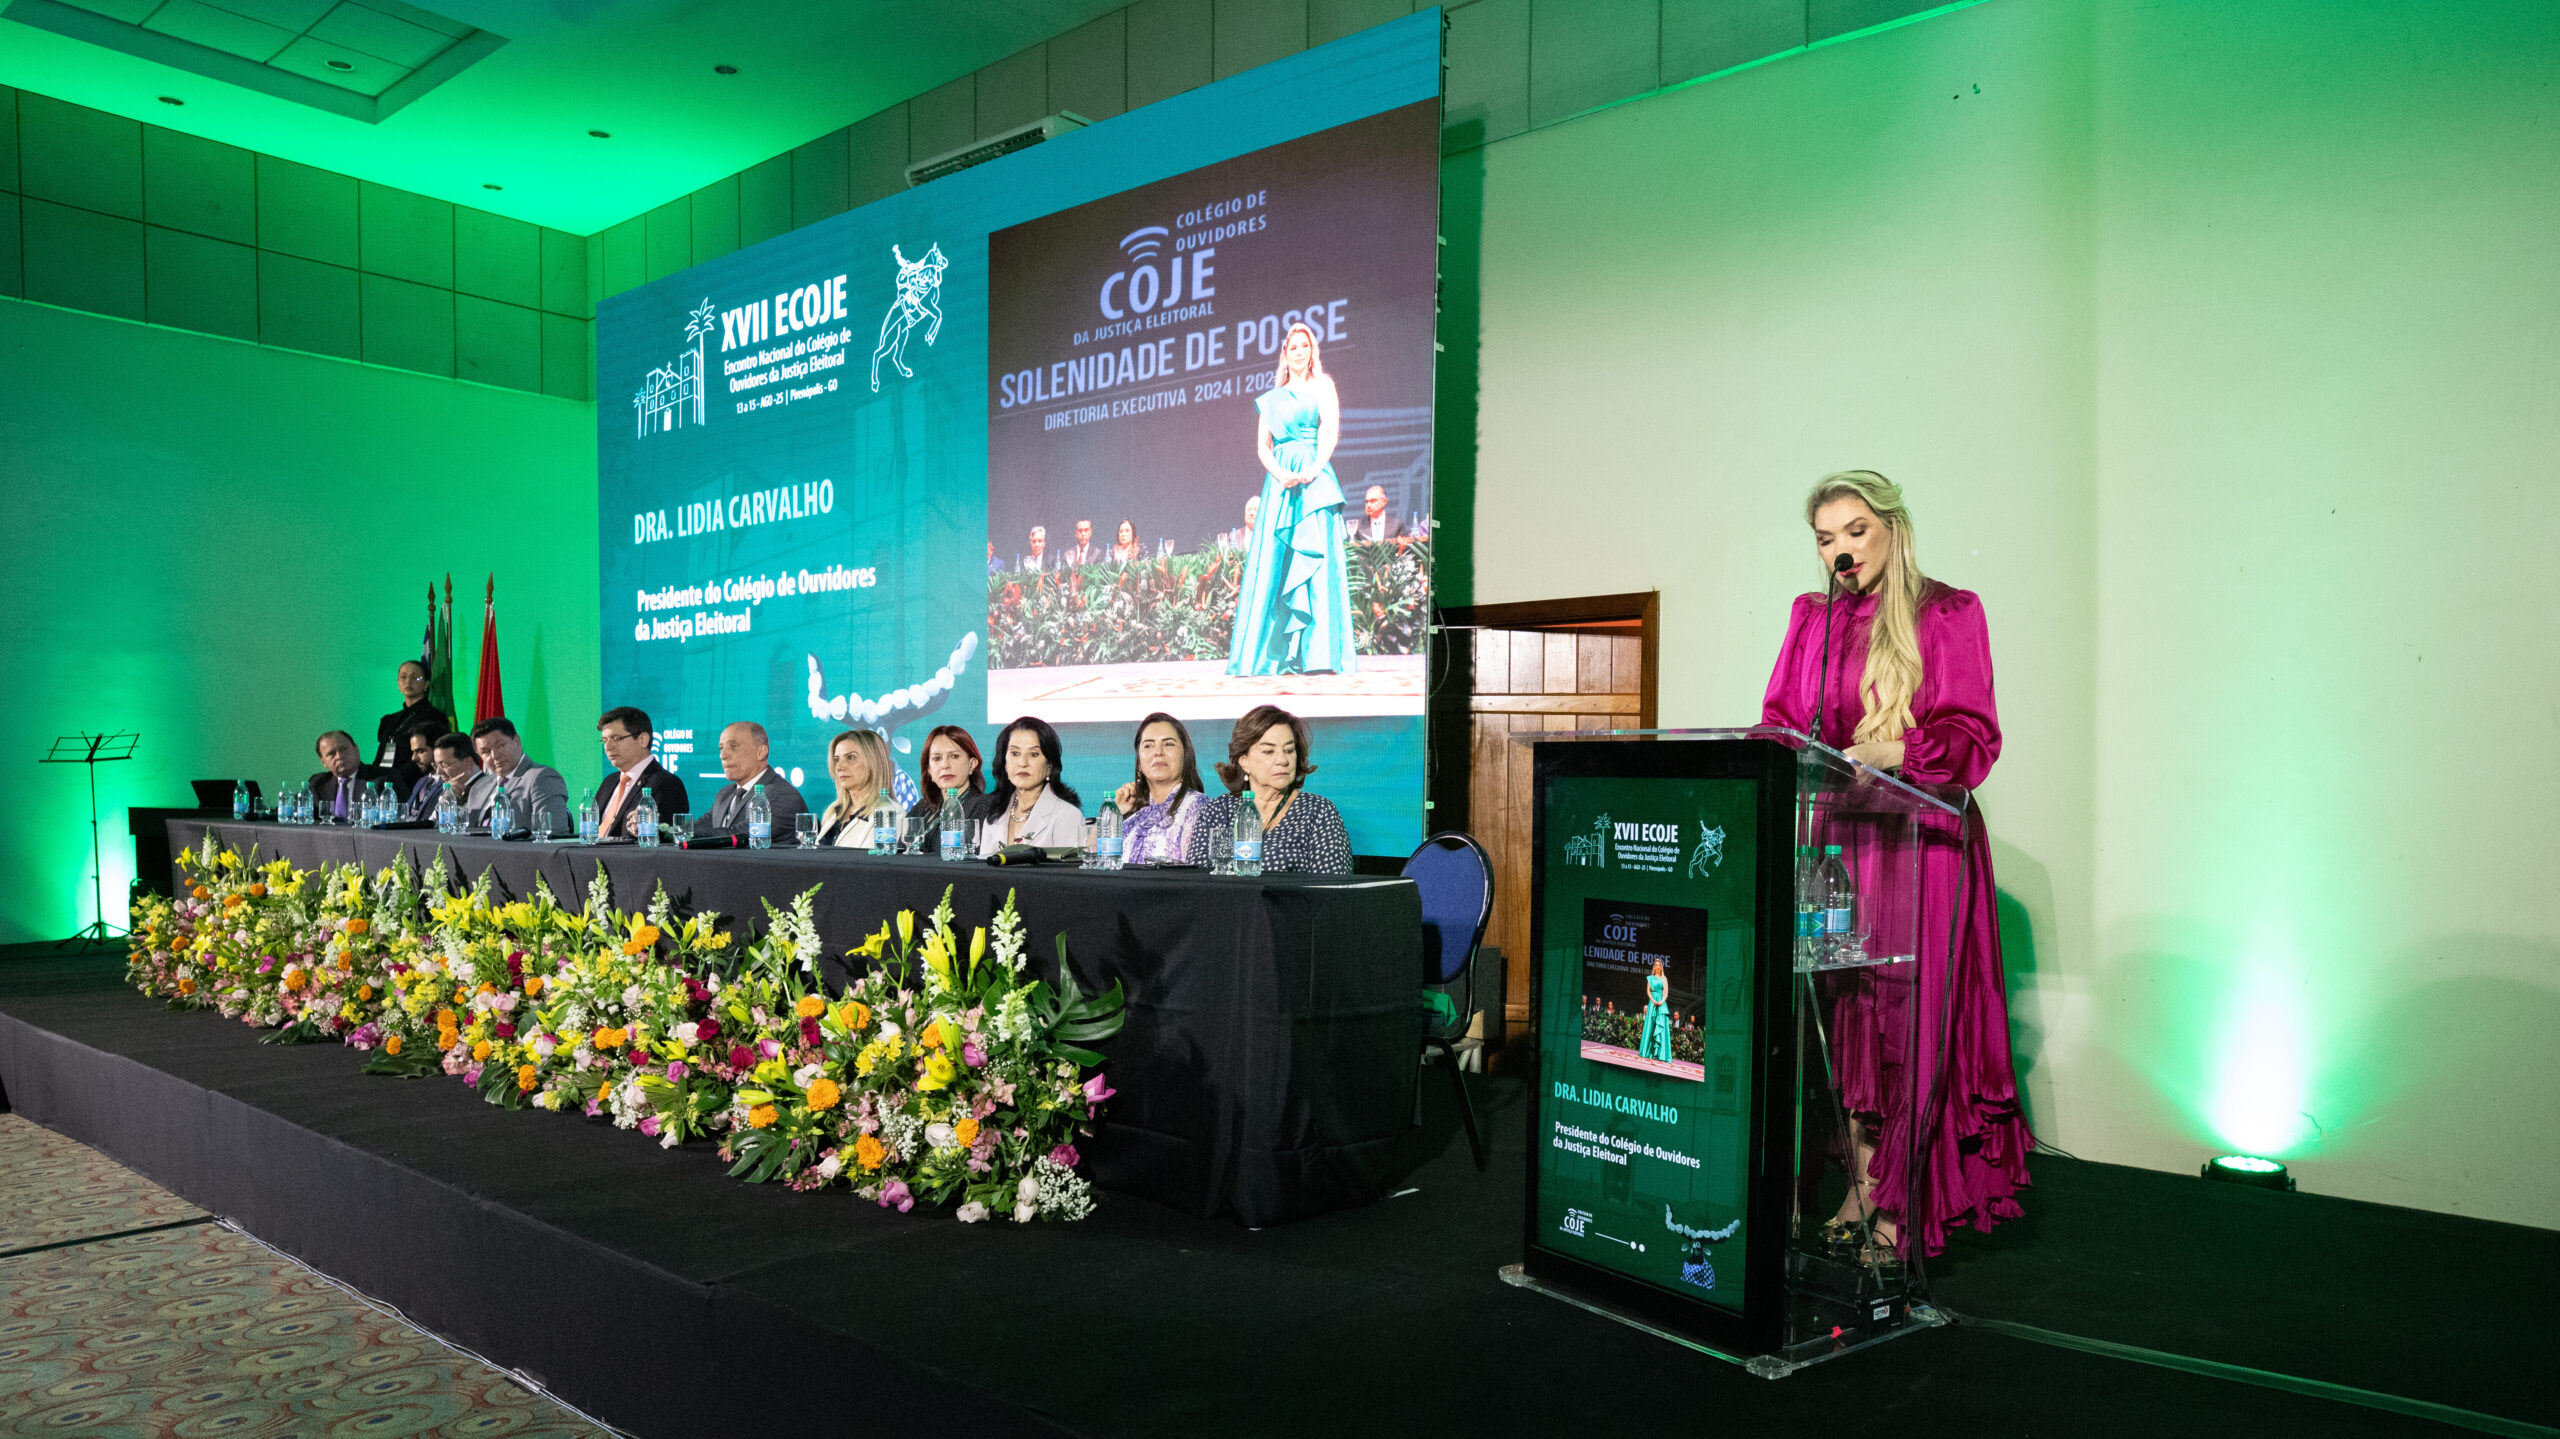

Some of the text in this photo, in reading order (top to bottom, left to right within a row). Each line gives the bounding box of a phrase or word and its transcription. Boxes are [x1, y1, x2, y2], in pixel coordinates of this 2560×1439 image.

[1176, 190, 1267, 229] COLÉGIO DE
[1176, 214, 1267, 251] OUVIDORES
[1100, 247, 1215, 320] COJE
[721, 274, 847, 352] XVII ECOJE
[1073, 301, 1214, 346] DA JUSTIÇA ELEITORAL
[724, 326, 852, 376] Encontro Nacional do Colégio de
[729, 347, 845, 393] Ouvidores da Justiça Eleitoral
[1000, 337, 1175, 408] SOLENIDADE
[1185, 326, 1226, 372] DE
[736, 402, 744, 414] 13
[743, 403, 748, 413] a
[749, 399, 756, 411] 15
[760, 394, 773, 408] AGO
[828, 378, 838, 392] GO
[1044, 403, 1109, 431] DIRETORIA
[1112, 388, 1187, 418] EXECUTIVA
[1194, 379, 1232, 403] 2024
[1245, 371, 1276, 393] 202
[634, 478, 834, 544] DRA. LIDIA CARVALHO
[637, 564, 876, 612] Presidente do Colégio de Ouvidores
[635, 607, 751, 643] da Justiça Eleitoral
[1613, 822, 1679, 843] XVII ECOJE
[1584, 945, 1625, 962] LENIDADE
[1627, 950, 1640, 964] DE
[1603, 924, 1637, 943] COJE
[1554, 1081, 1678, 1125] DRA. LIDIA CARVALHO
[1553, 1136, 1627, 1166] da Justiça Eleitoral
[1555, 1121, 1700, 1169] Presidente do Colégio de Ouvidores
[1563, 1215, 1585, 1234] COJE
